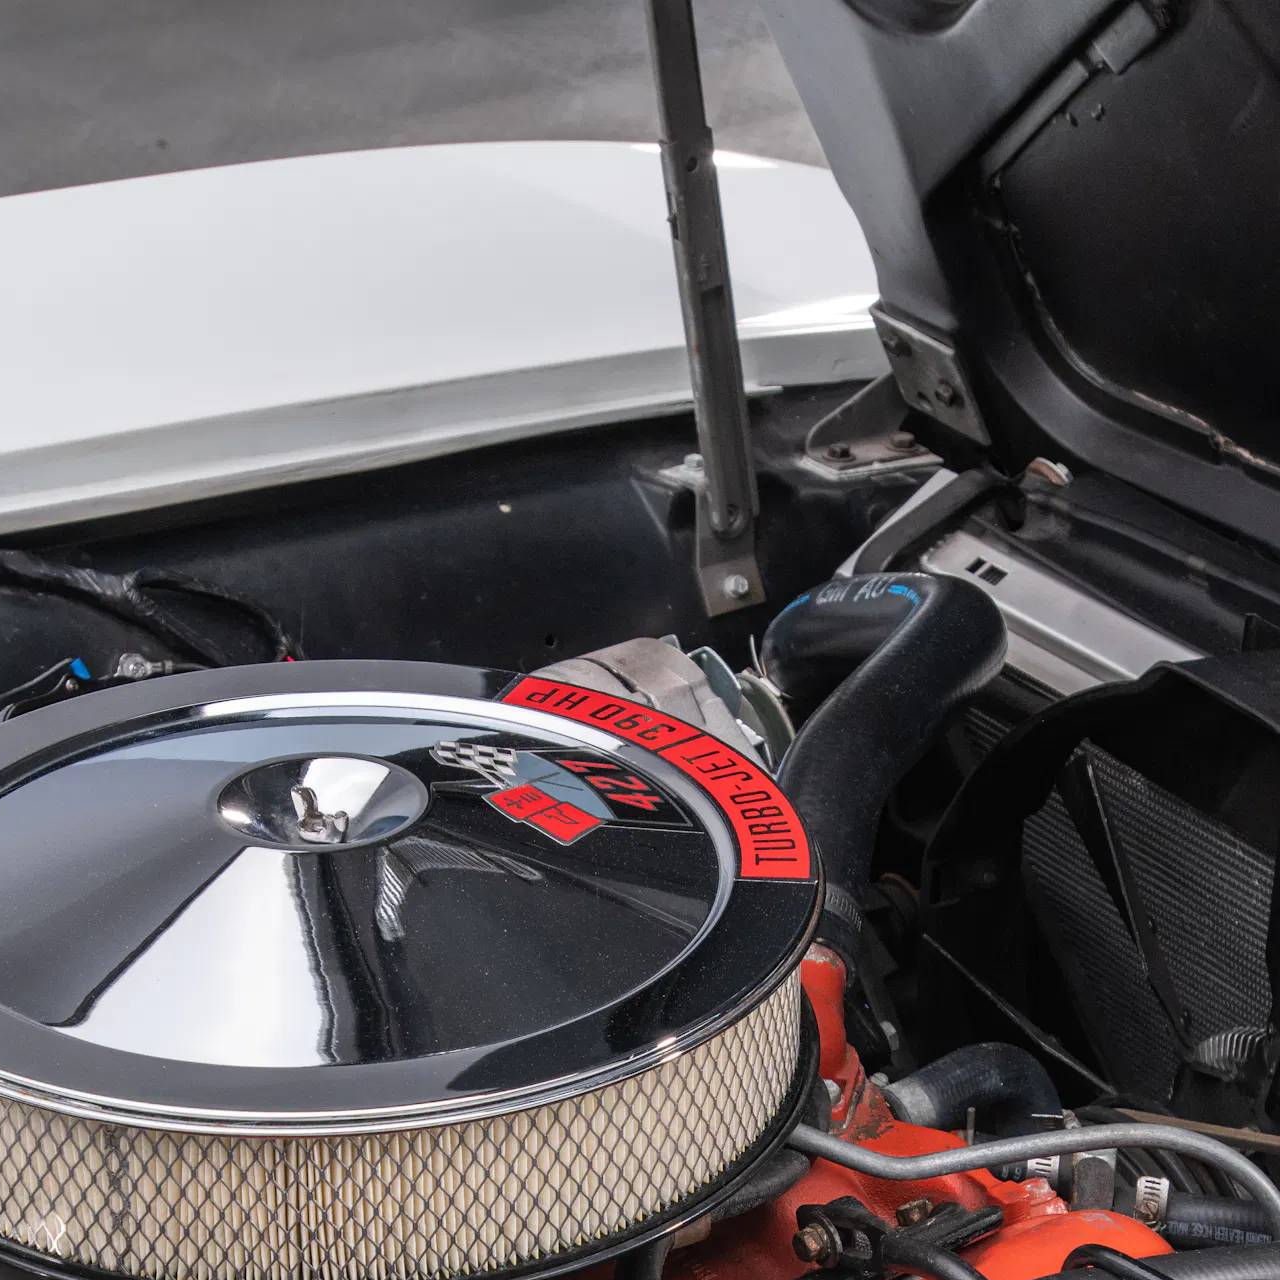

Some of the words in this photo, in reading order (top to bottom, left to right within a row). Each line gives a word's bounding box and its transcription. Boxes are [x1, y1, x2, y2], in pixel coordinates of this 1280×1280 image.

[525, 688, 592, 711] HP
[589, 703, 676, 741] 390
[555, 759, 663, 811] 427
[681, 750, 797, 866] TURBO-JET
